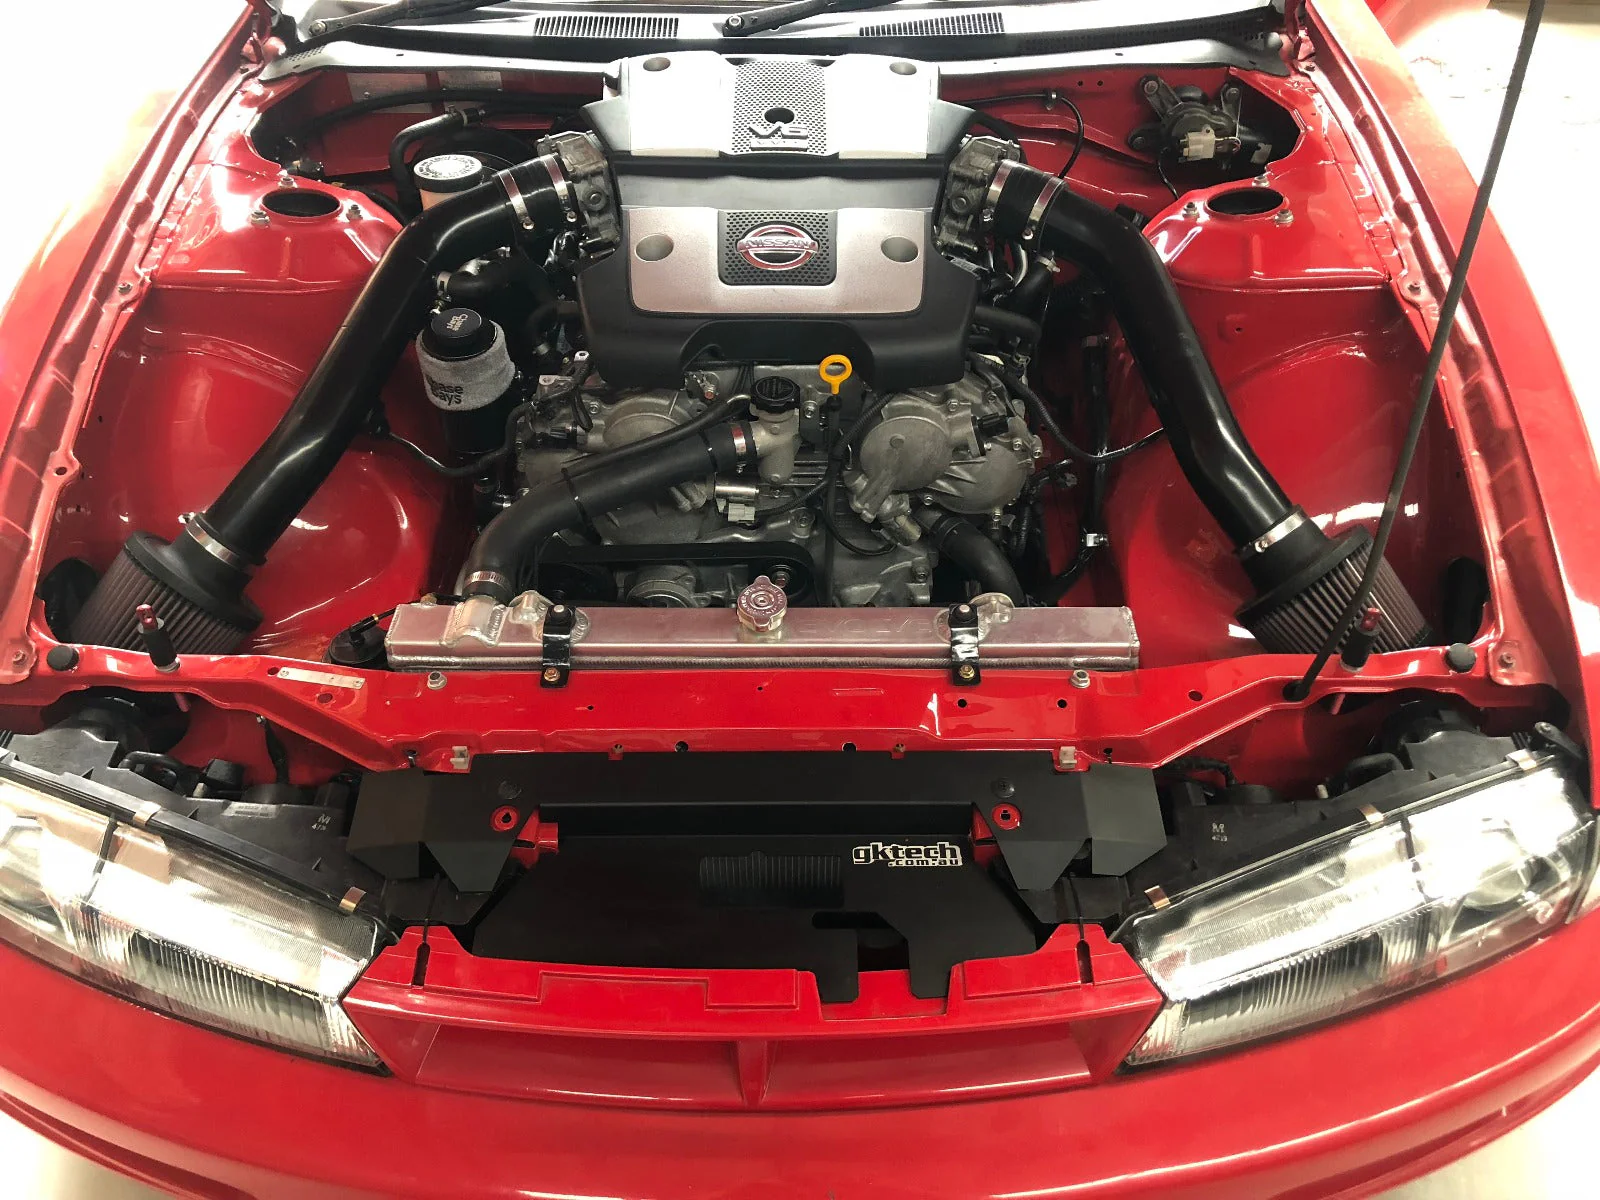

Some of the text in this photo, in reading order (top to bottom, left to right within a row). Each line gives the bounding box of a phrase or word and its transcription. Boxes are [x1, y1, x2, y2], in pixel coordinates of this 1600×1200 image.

[748, 121, 809, 139] V6
[744, 239, 810, 249] NISSAN
[852, 841, 961, 865] gktech
[888, 858, 962, 867] .com.au
